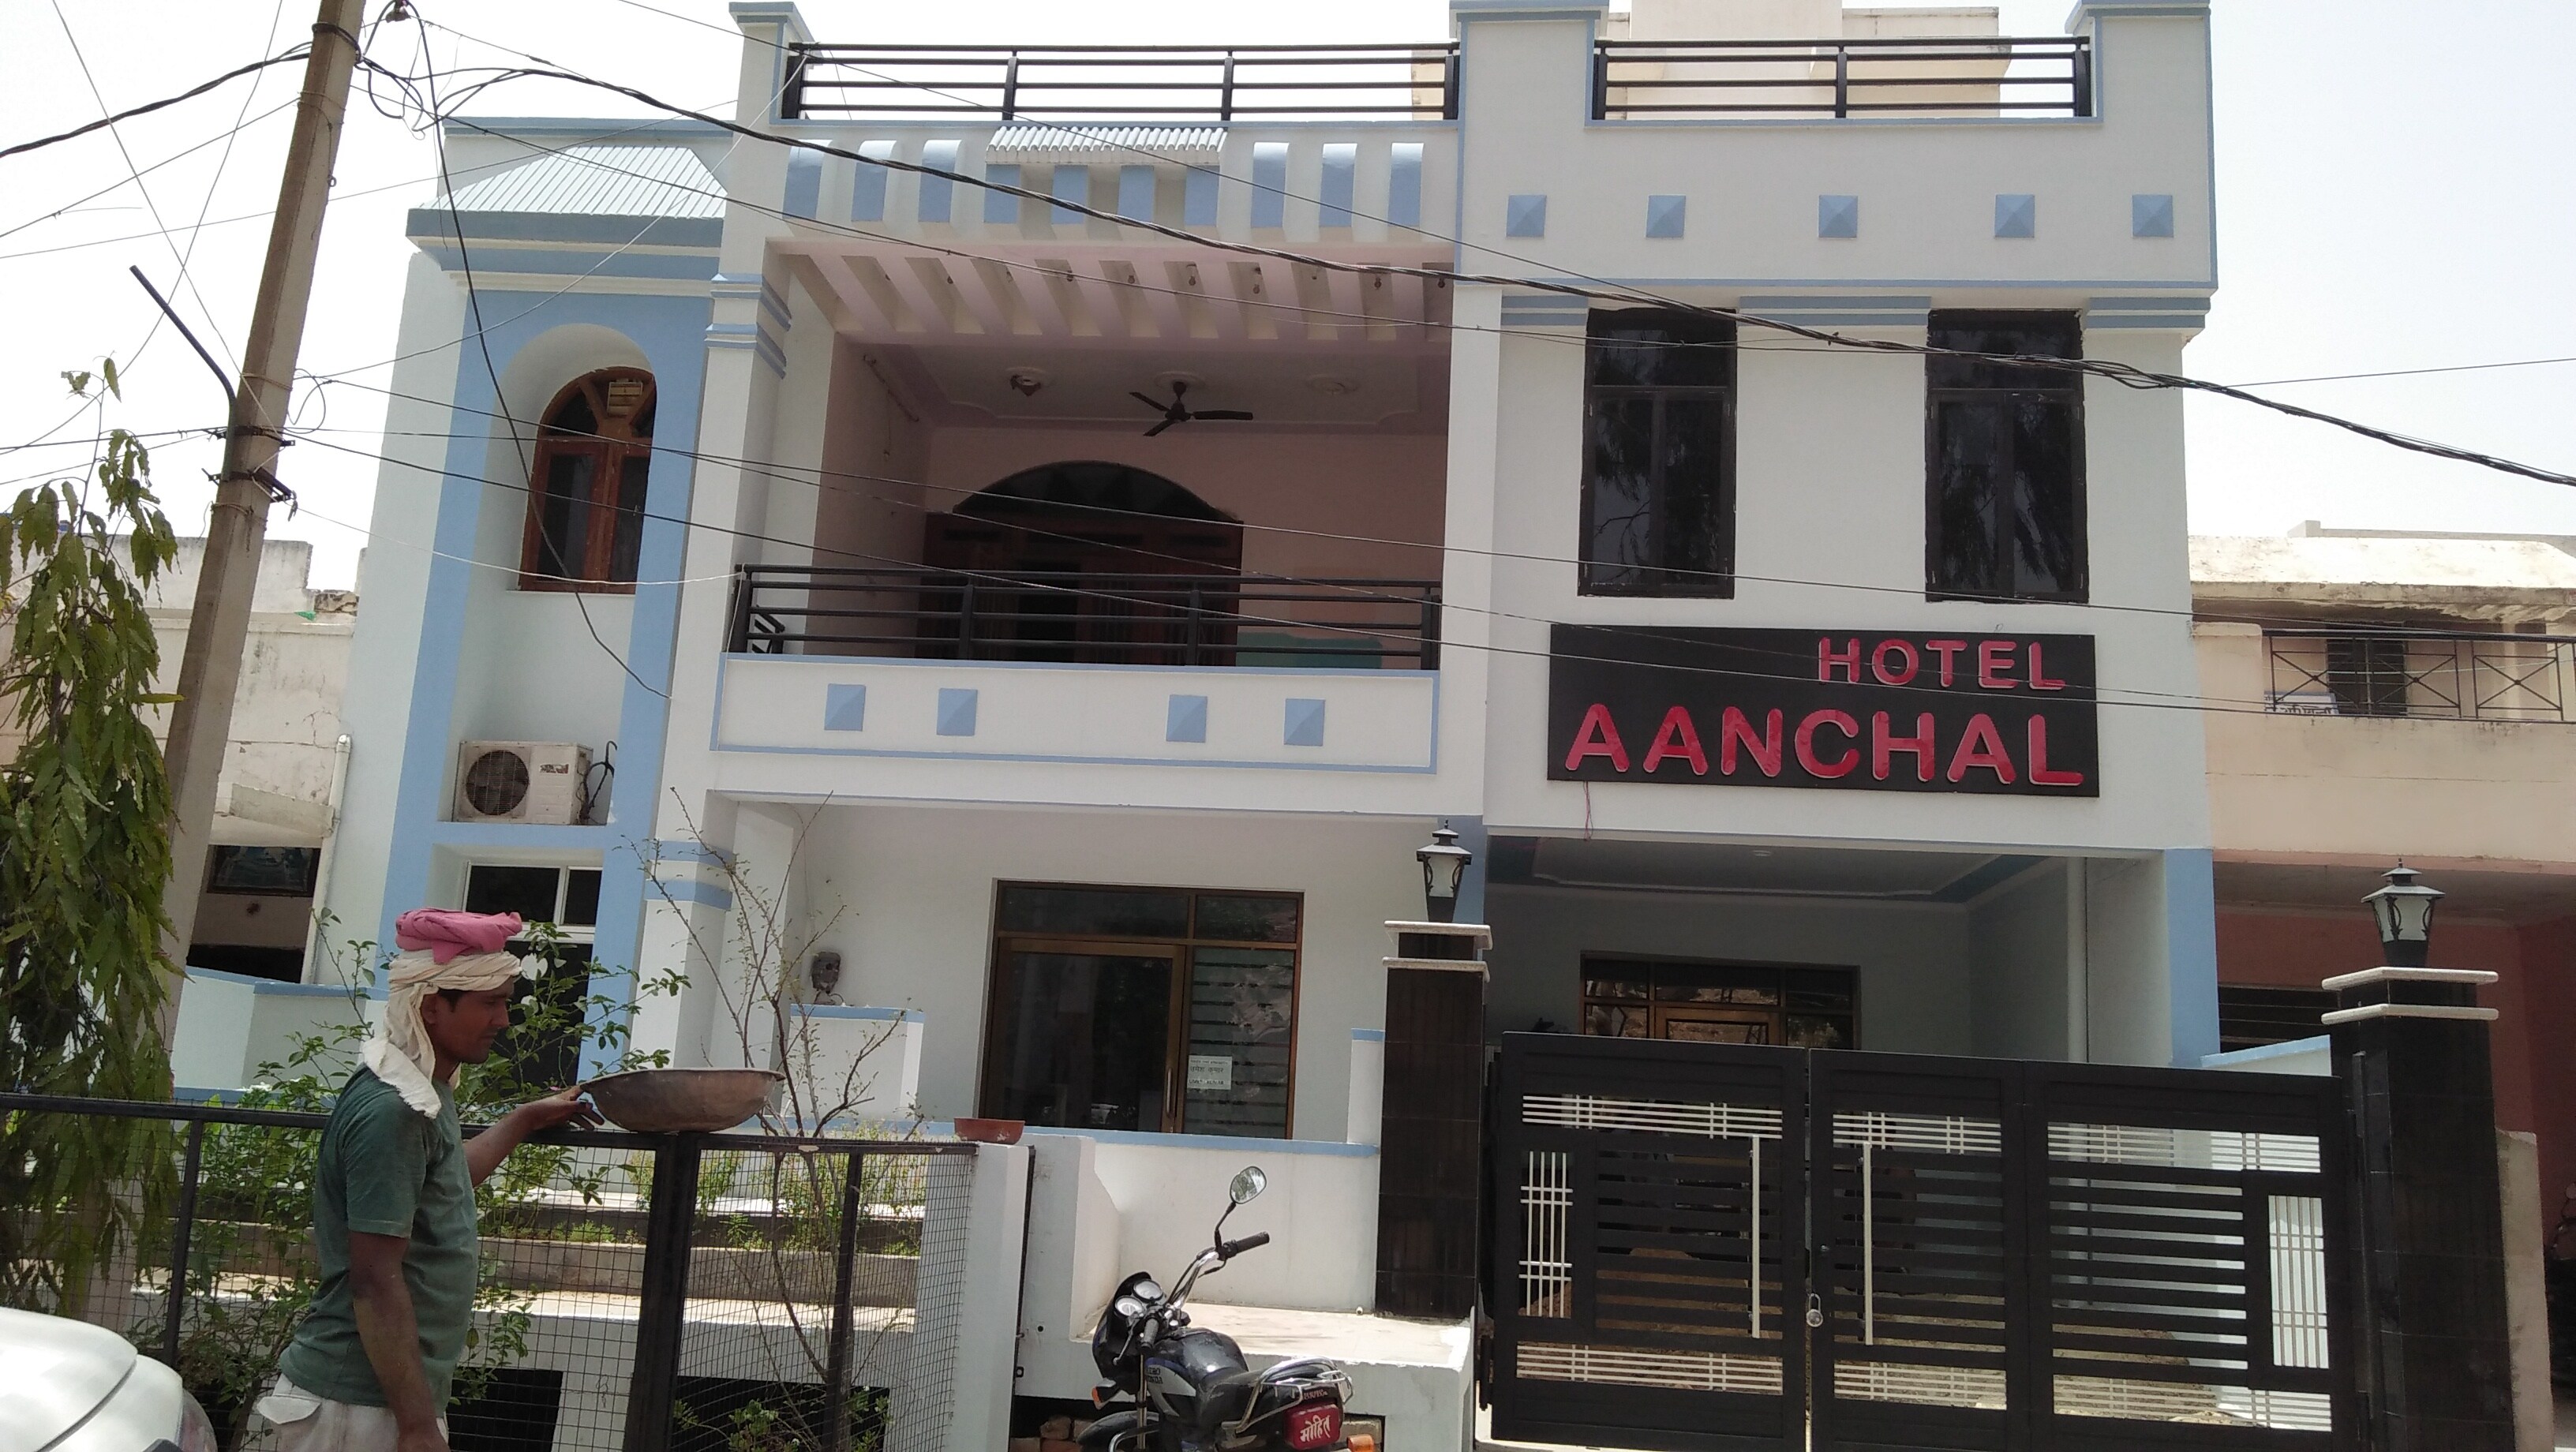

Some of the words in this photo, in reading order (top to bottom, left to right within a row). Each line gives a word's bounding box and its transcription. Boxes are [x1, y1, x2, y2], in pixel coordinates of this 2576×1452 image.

[1818, 638, 2065, 690] HOTEL
[1565, 703, 2084, 785] AANCHAL
[1300, 1415, 1331, 1443] मोहित
